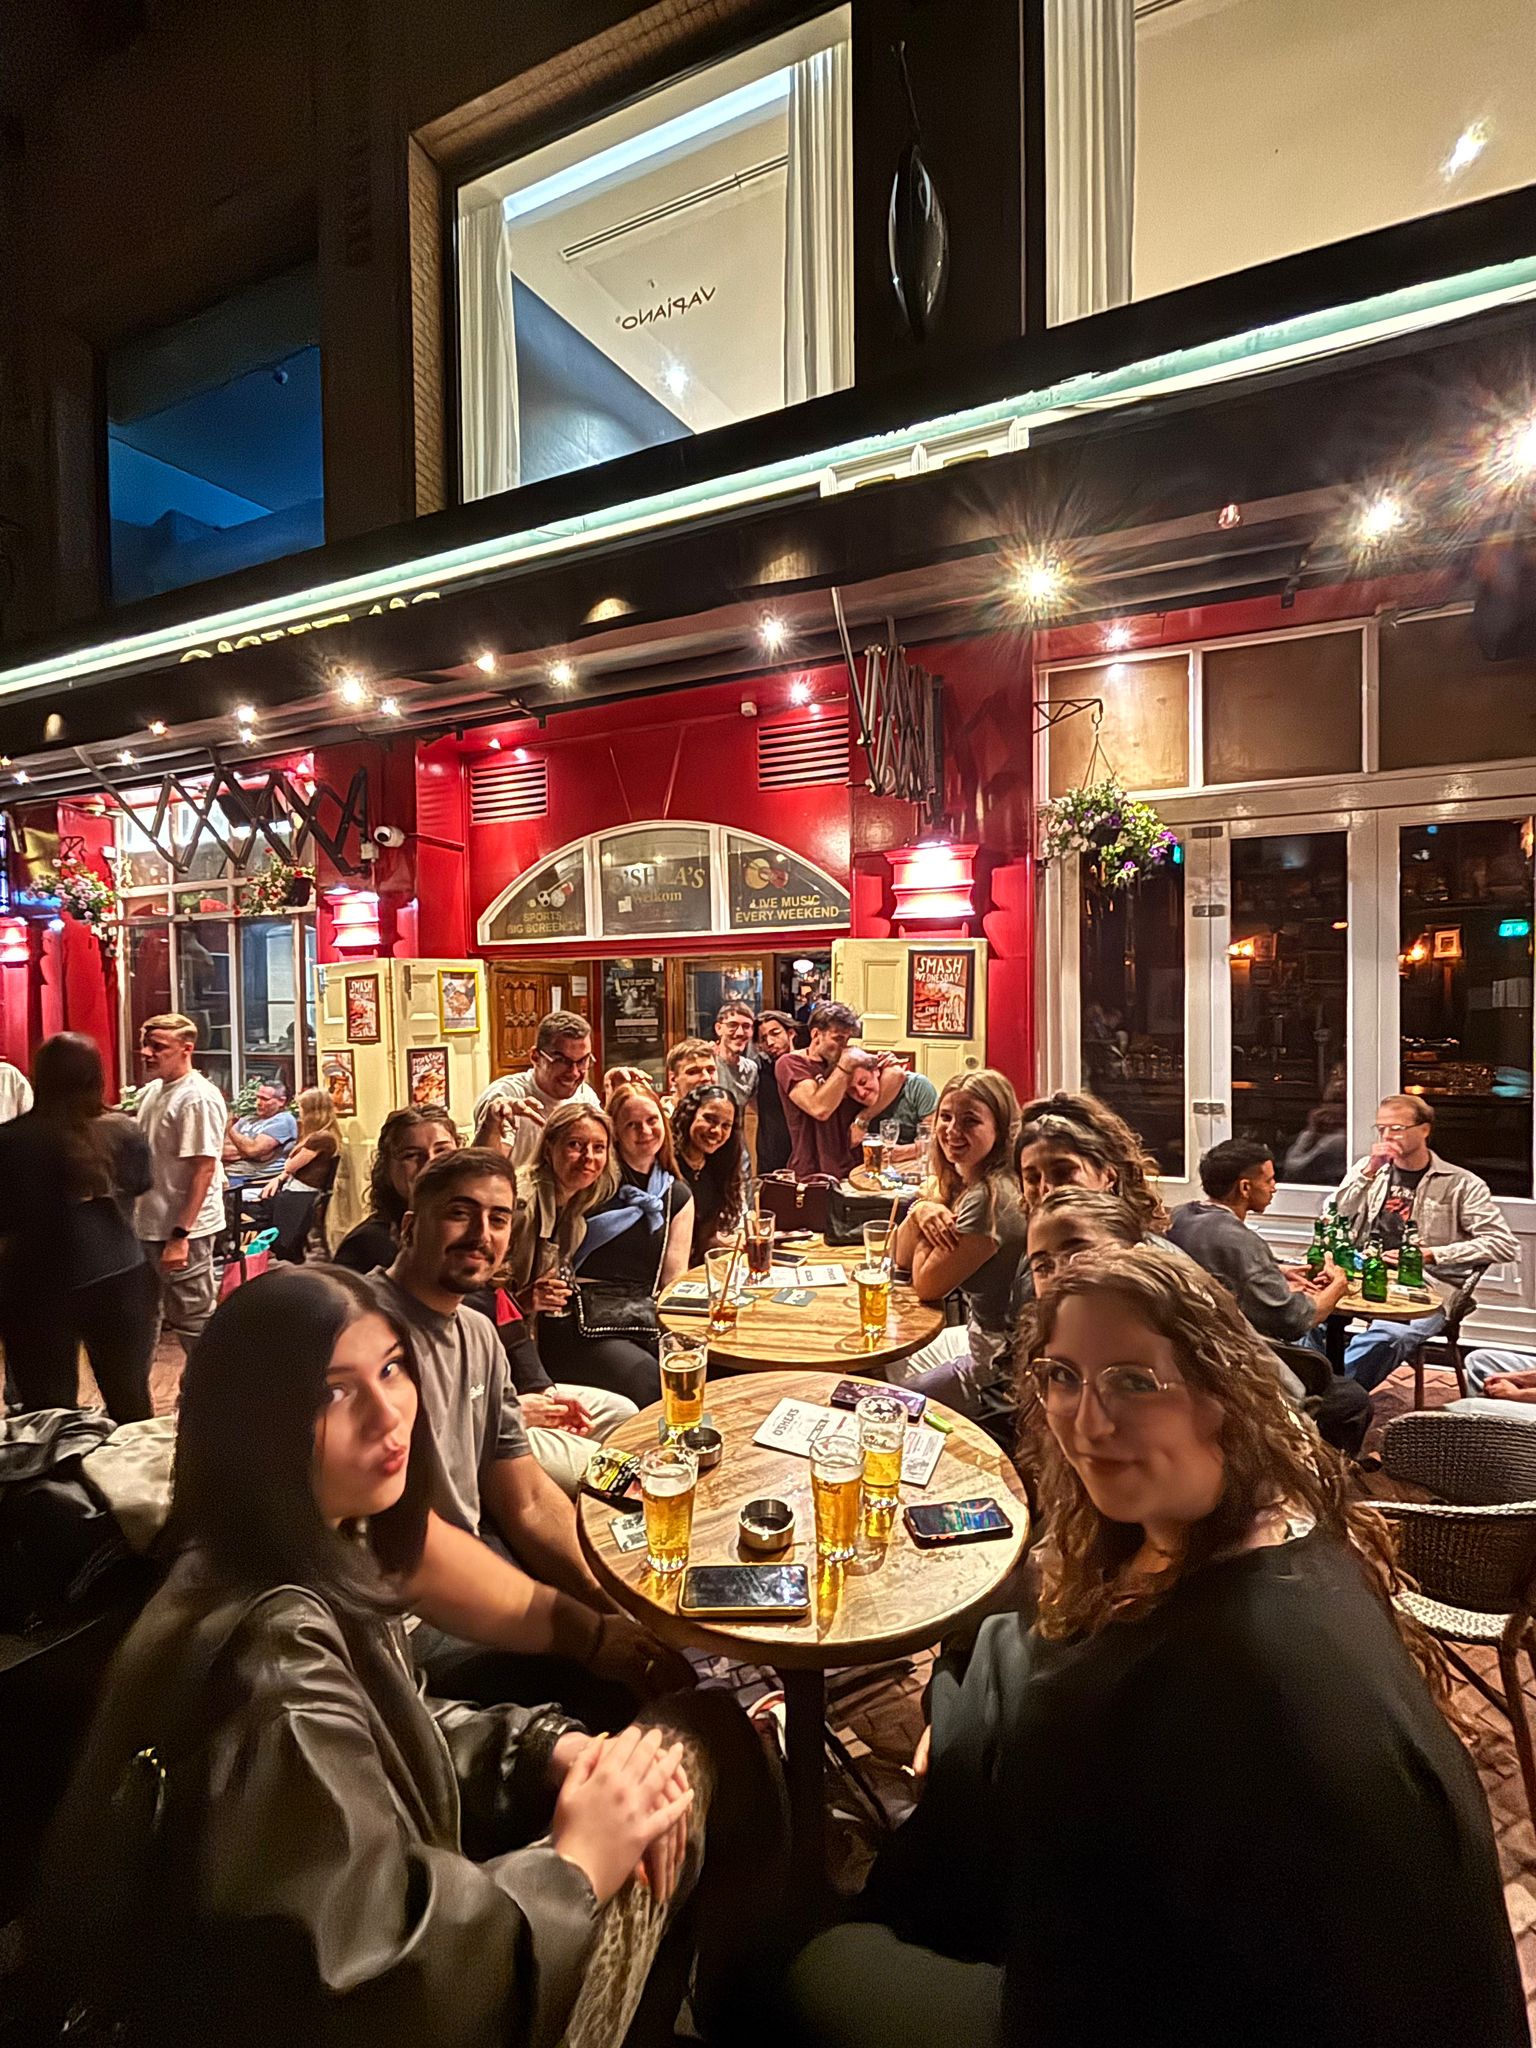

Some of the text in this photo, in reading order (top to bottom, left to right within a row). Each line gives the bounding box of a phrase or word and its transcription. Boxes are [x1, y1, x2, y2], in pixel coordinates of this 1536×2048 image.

[750, 894, 820, 909] LIVE MUSIC
[523, 911, 562, 922] SPORTS
[735, 905, 839, 923] EVERY WEEKEND
[507, 924, 524, 934] BIG
[525, 922, 566, 933] SCREEN
[917, 956, 963, 974] SMASH
[915, 972, 960, 985] WEDNESDAY
[349, 980, 373, 993] SMASH
